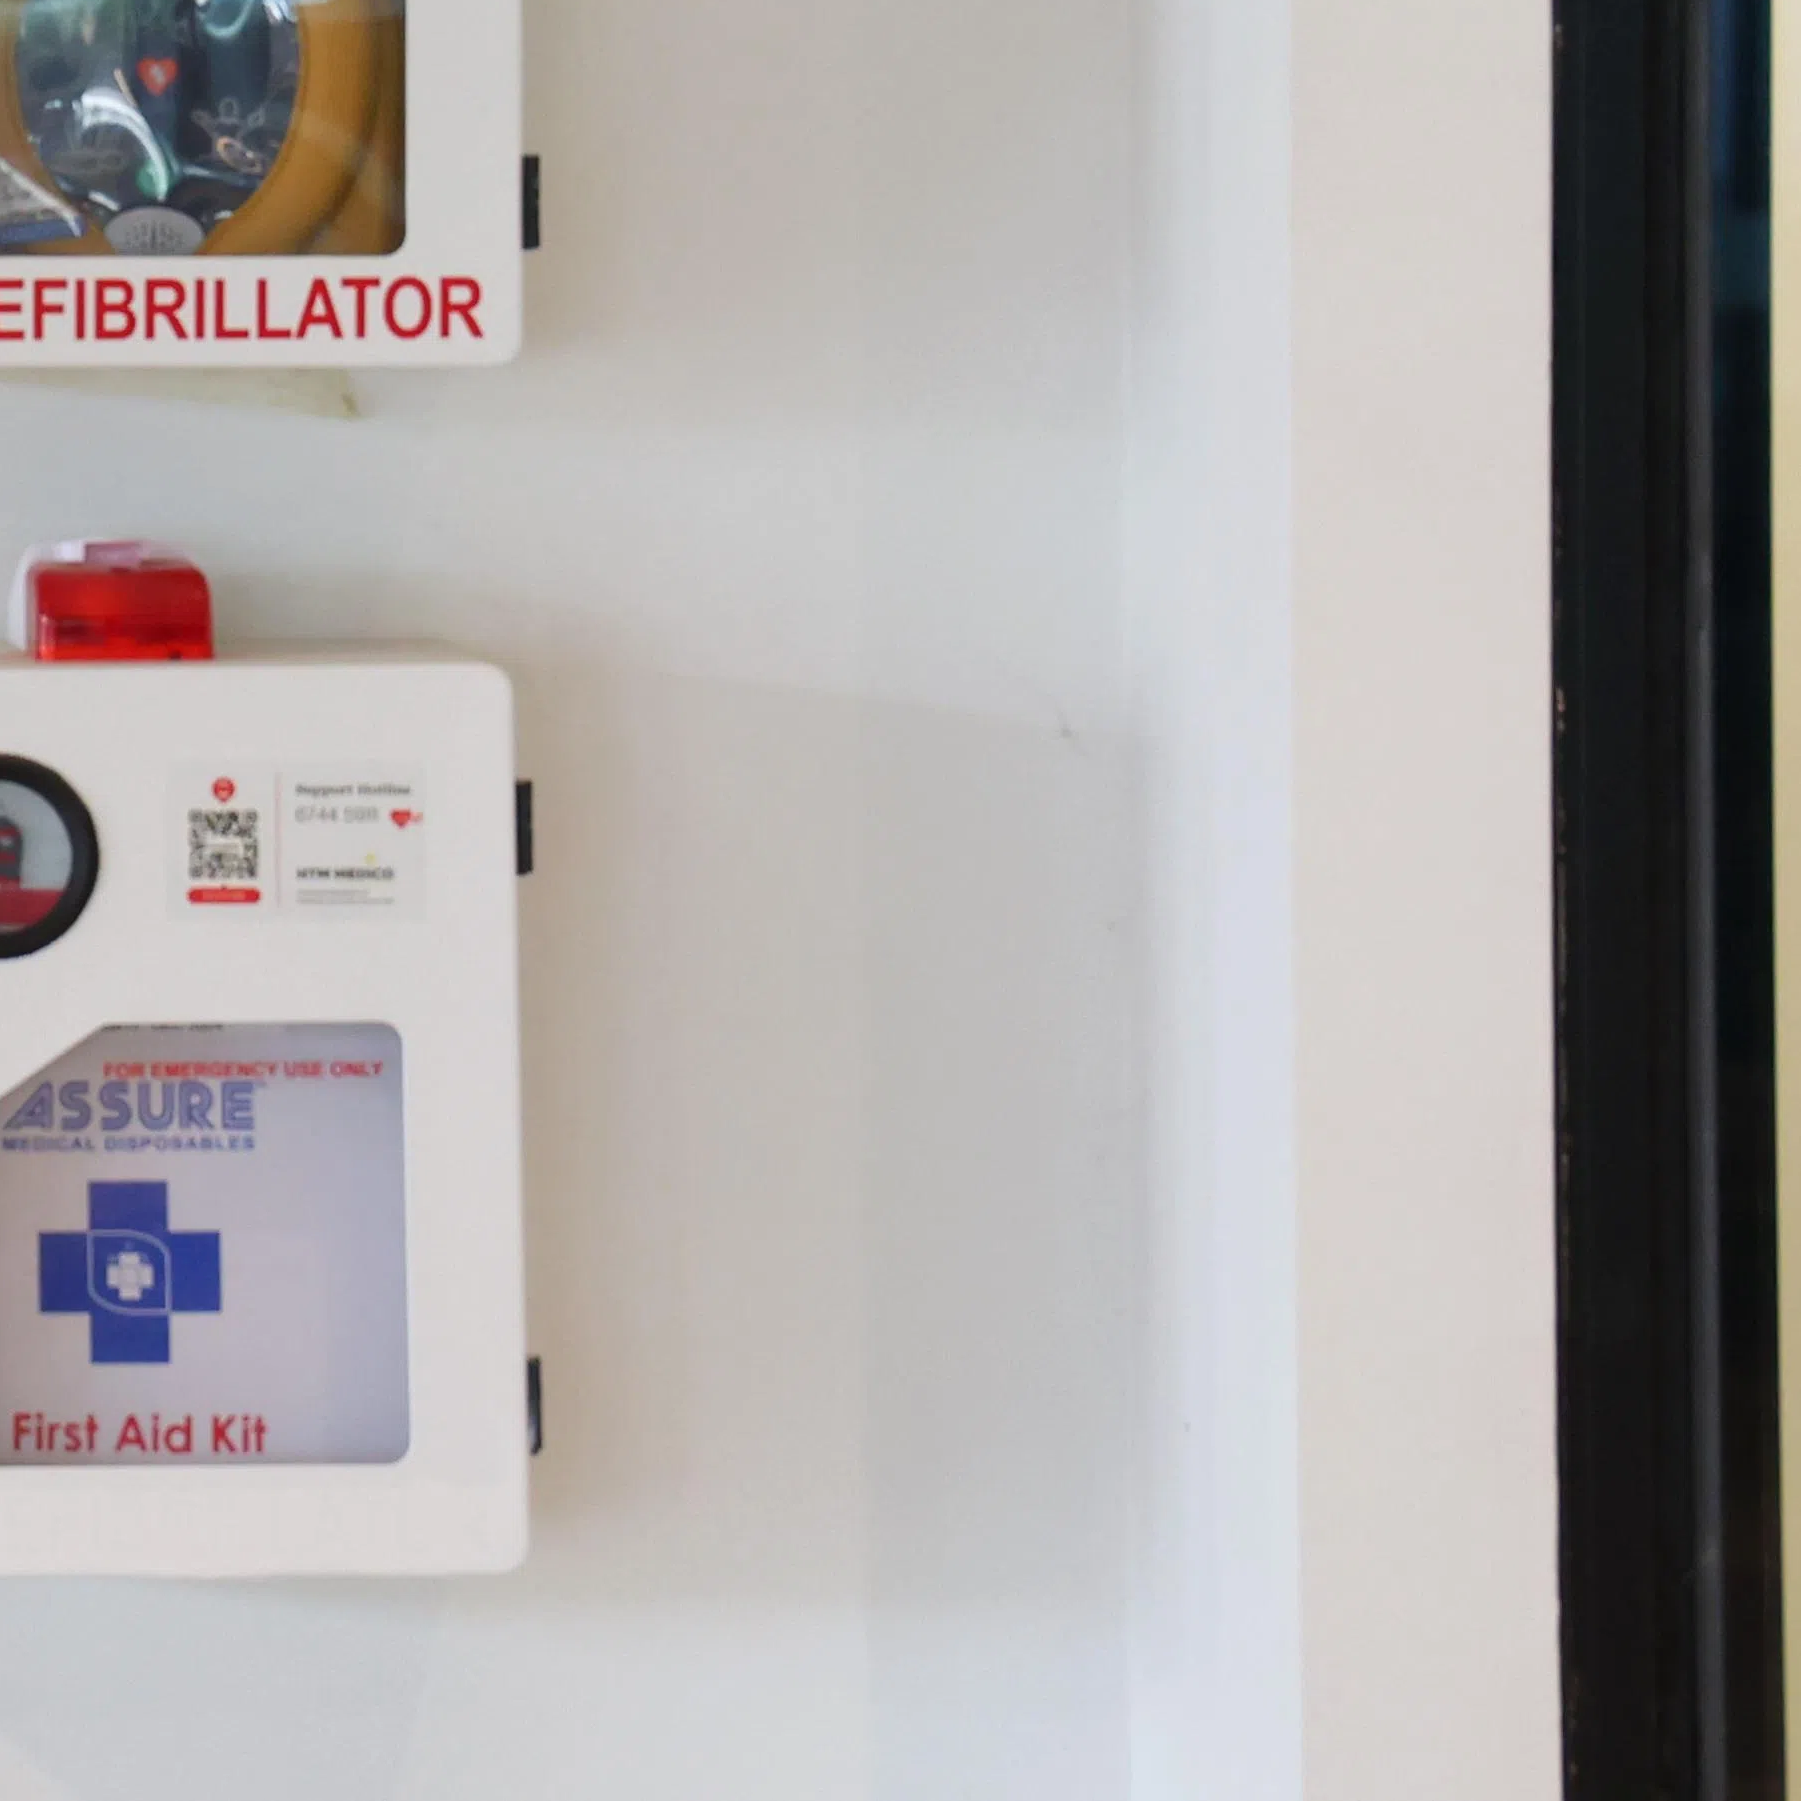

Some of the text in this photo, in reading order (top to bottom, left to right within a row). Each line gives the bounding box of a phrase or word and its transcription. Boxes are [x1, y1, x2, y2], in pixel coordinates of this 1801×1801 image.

[103, 1061, 383, 1078] FOR EMERGENCY USE ONLY
[2, 1081, 255, 1131] ASSURE
[3, 1136, 255, 1152] MEDICAL DISPOSABLES
[13, 1411, 267, 1453] First Aid Kit
